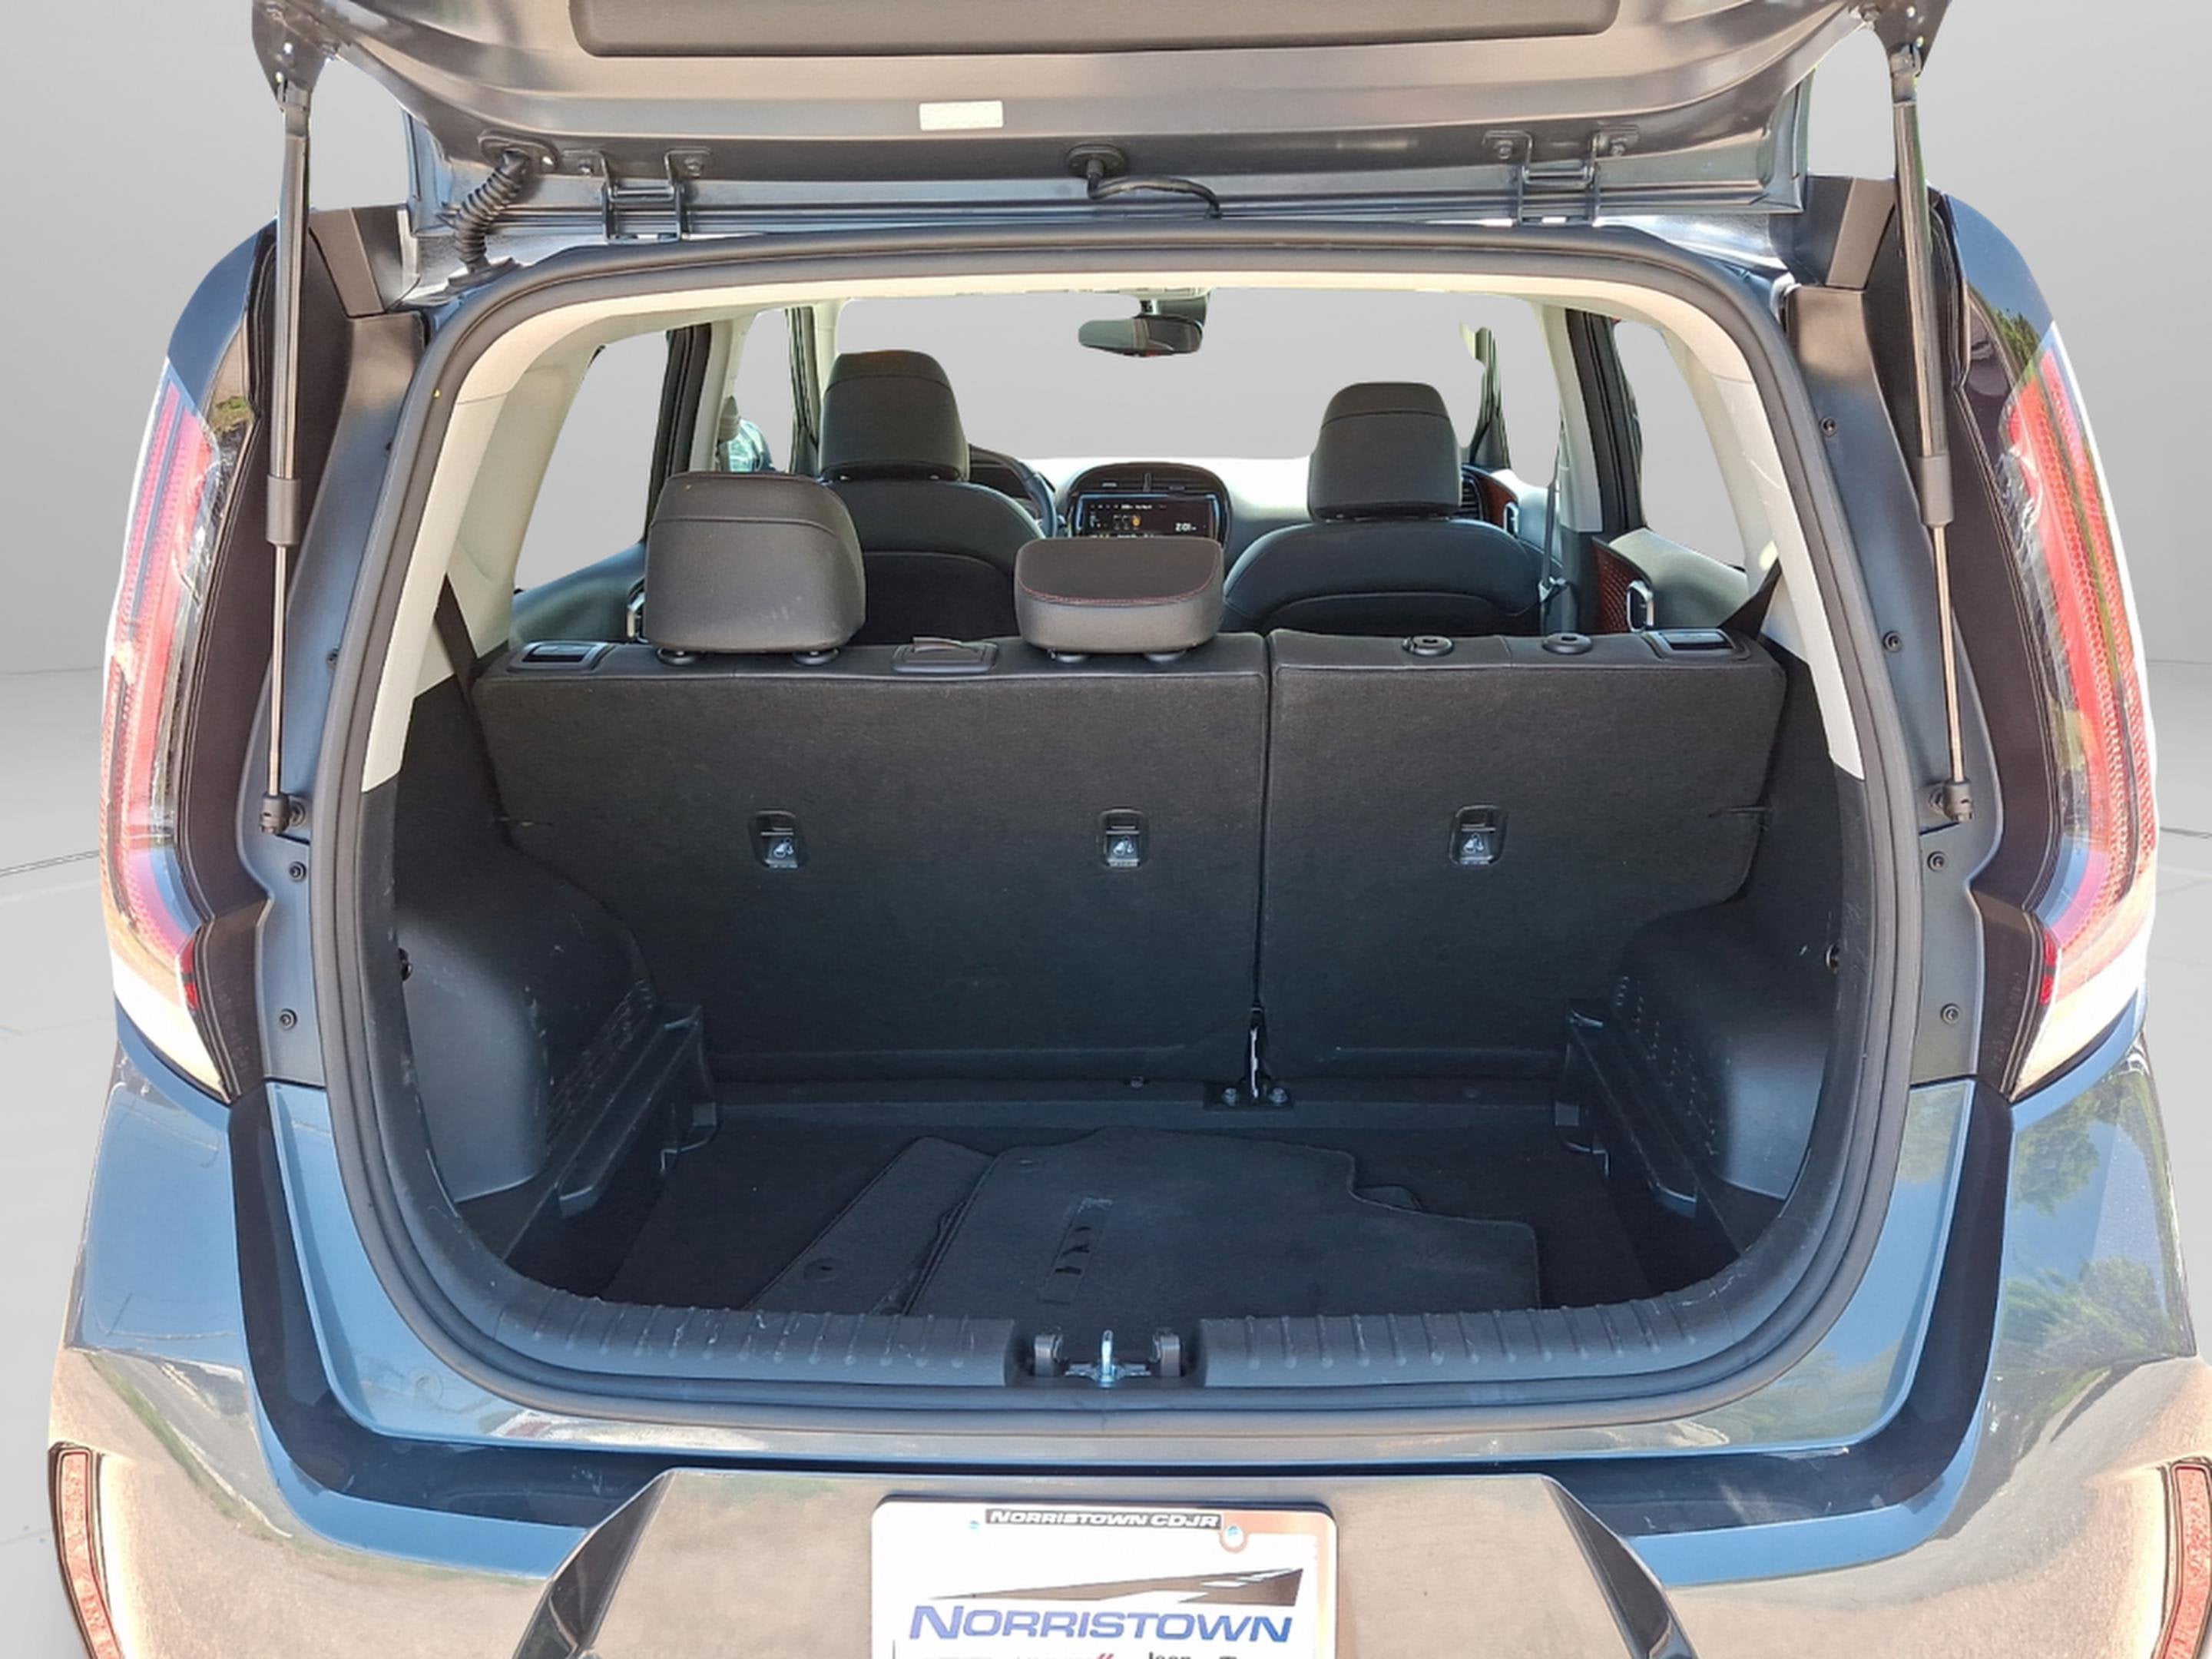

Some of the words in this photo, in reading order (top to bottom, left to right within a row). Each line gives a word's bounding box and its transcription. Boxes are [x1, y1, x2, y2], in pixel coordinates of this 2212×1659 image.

[989, 1510, 1147, 1525] NORRISTOWN
[1151, 1513, 1220, 1528] CDJR
[909, 1605, 1293, 1643] NORRISTOWN
